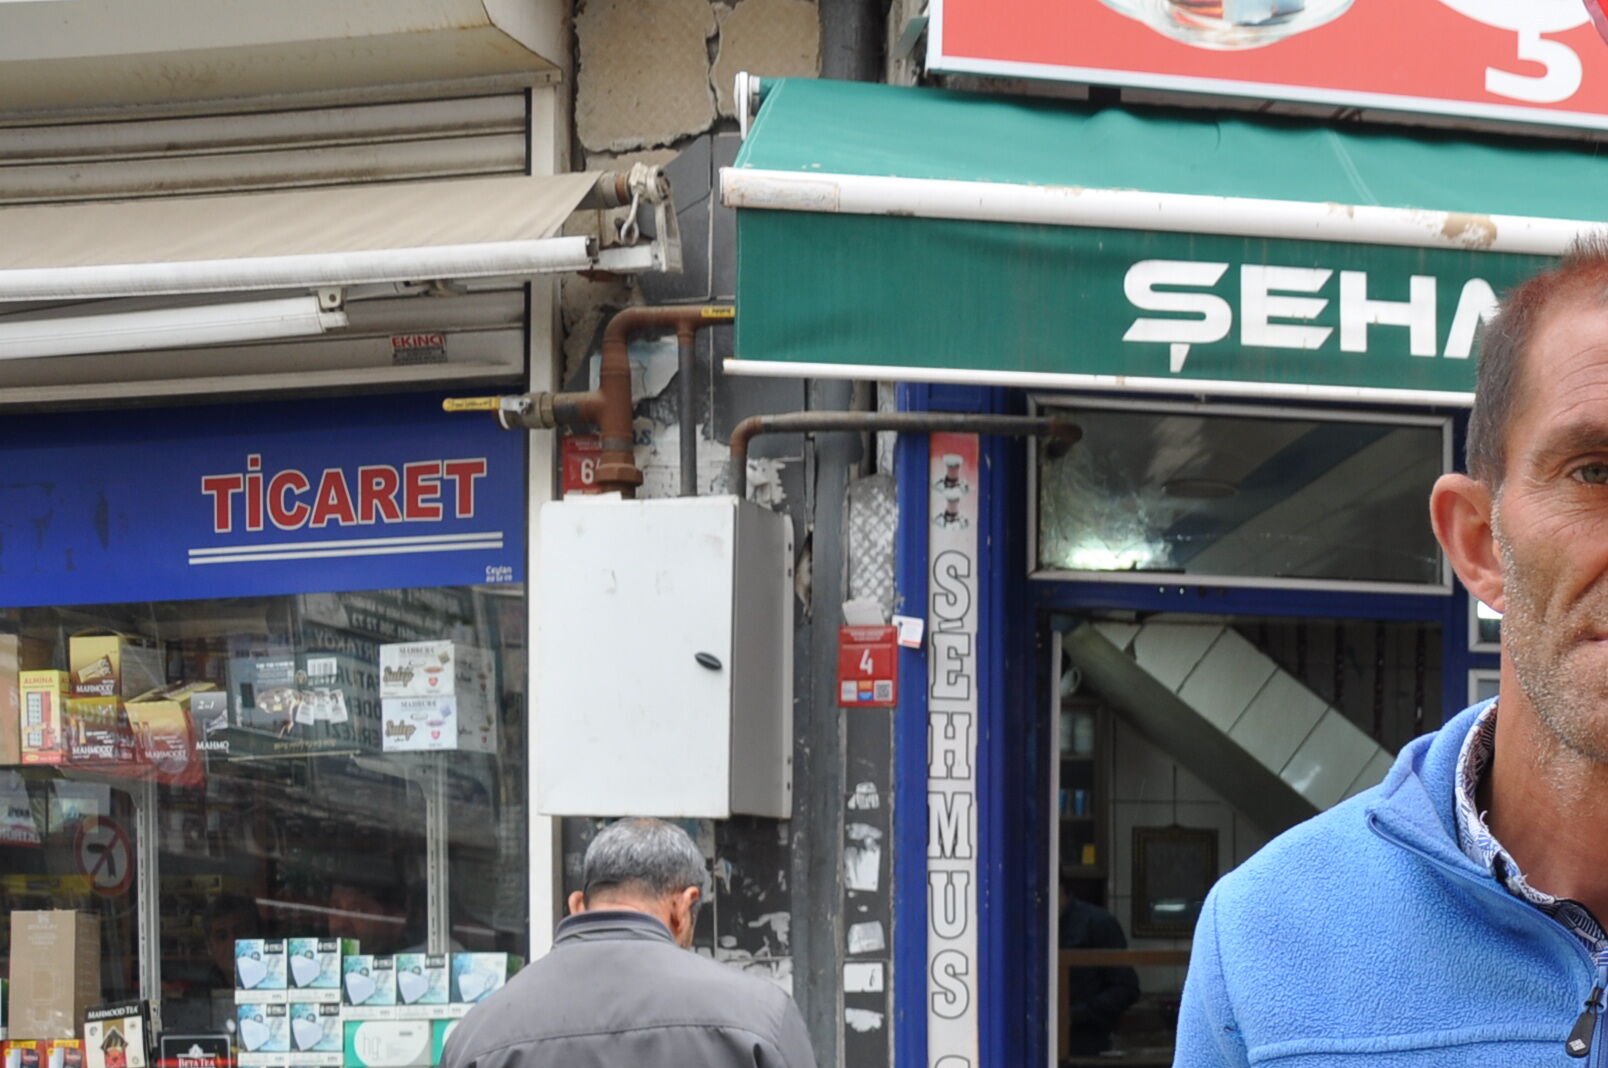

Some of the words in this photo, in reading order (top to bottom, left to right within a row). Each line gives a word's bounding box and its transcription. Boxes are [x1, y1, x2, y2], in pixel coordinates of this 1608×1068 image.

[1122, 259, 1500, 374] ŞEH
[200, 452, 489, 535] TİCARET
[858, 648, 874, 676] 4
[928, 549, 973, 1020] ŞEHMUS
[88, 1006, 125, 1019] MAHMOOD
[126, 1004, 139, 1015] TEA
